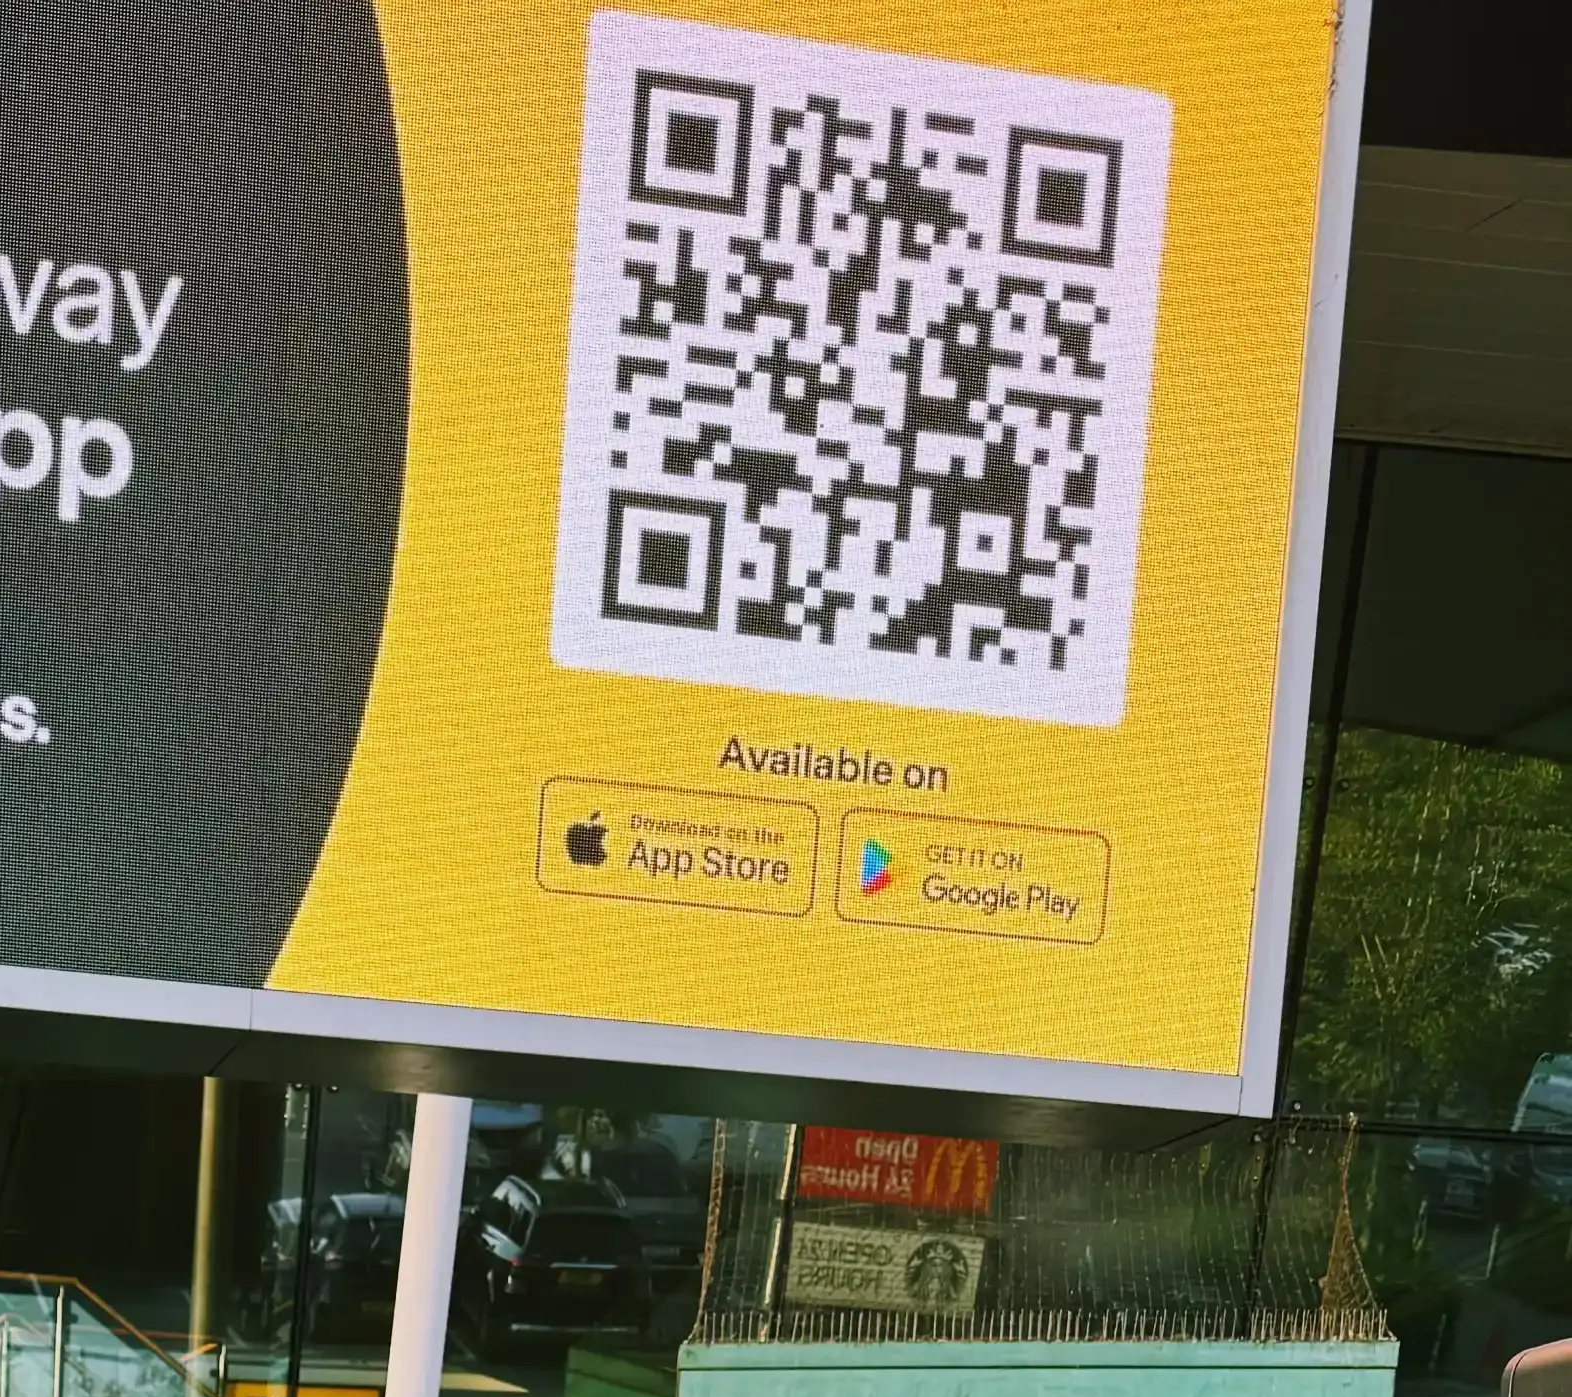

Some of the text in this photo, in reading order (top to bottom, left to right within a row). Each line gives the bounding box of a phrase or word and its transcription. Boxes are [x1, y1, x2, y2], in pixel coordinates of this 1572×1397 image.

[718, 736, 948, 792] Available on
[629, 813, 721, 839] Download
[754, 827, 785, 844] the
[628, 840, 789, 885] App Store
[925, 844, 1024, 872] GET IT ON
[921, 874, 1080, 923] Google Play
